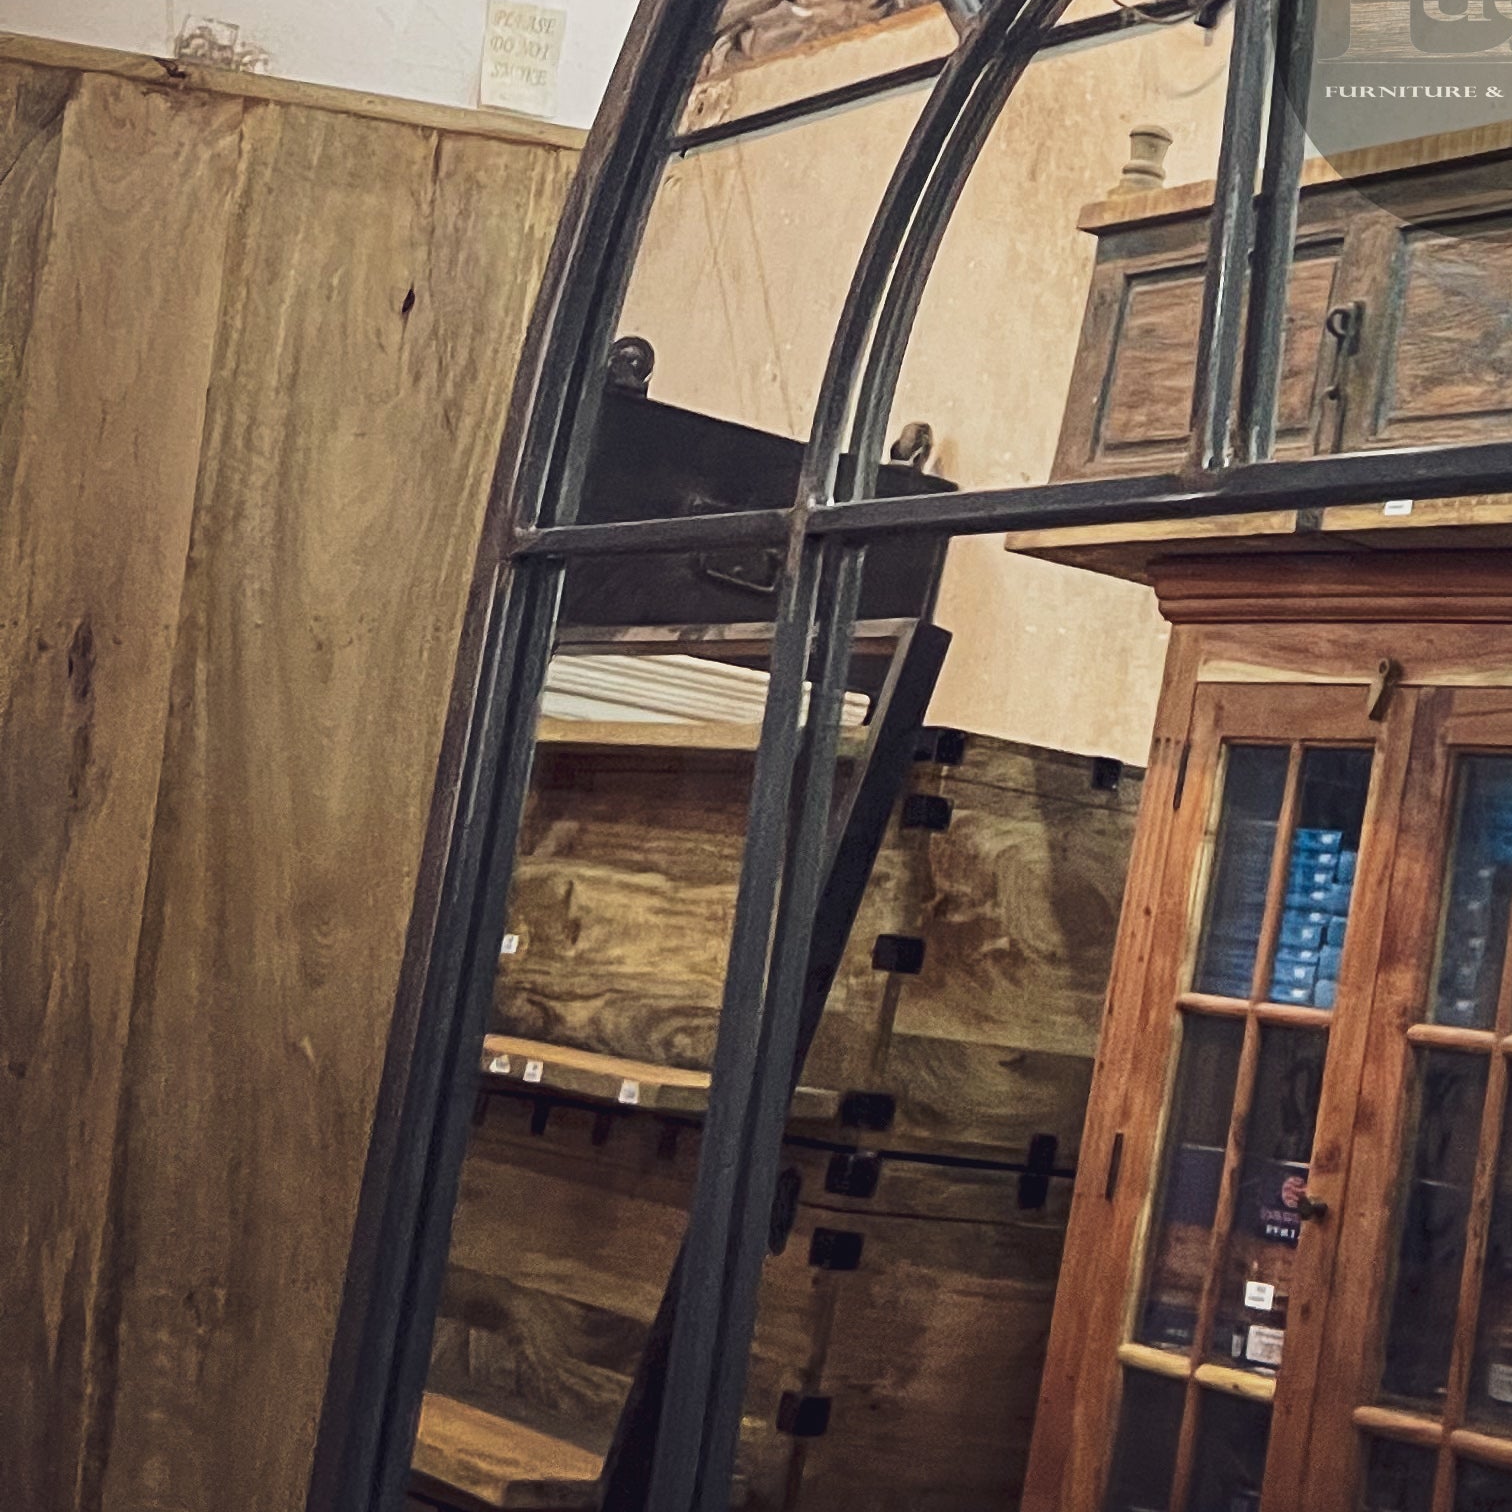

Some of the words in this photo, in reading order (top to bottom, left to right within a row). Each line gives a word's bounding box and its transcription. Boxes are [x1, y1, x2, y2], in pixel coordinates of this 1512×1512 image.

[494, 10, 556, 34] PLEASE
[490, 35, 515, 54] DO
[516, 38, 550, 62] NOT
[491, 62, 547, 86] SMOKE
